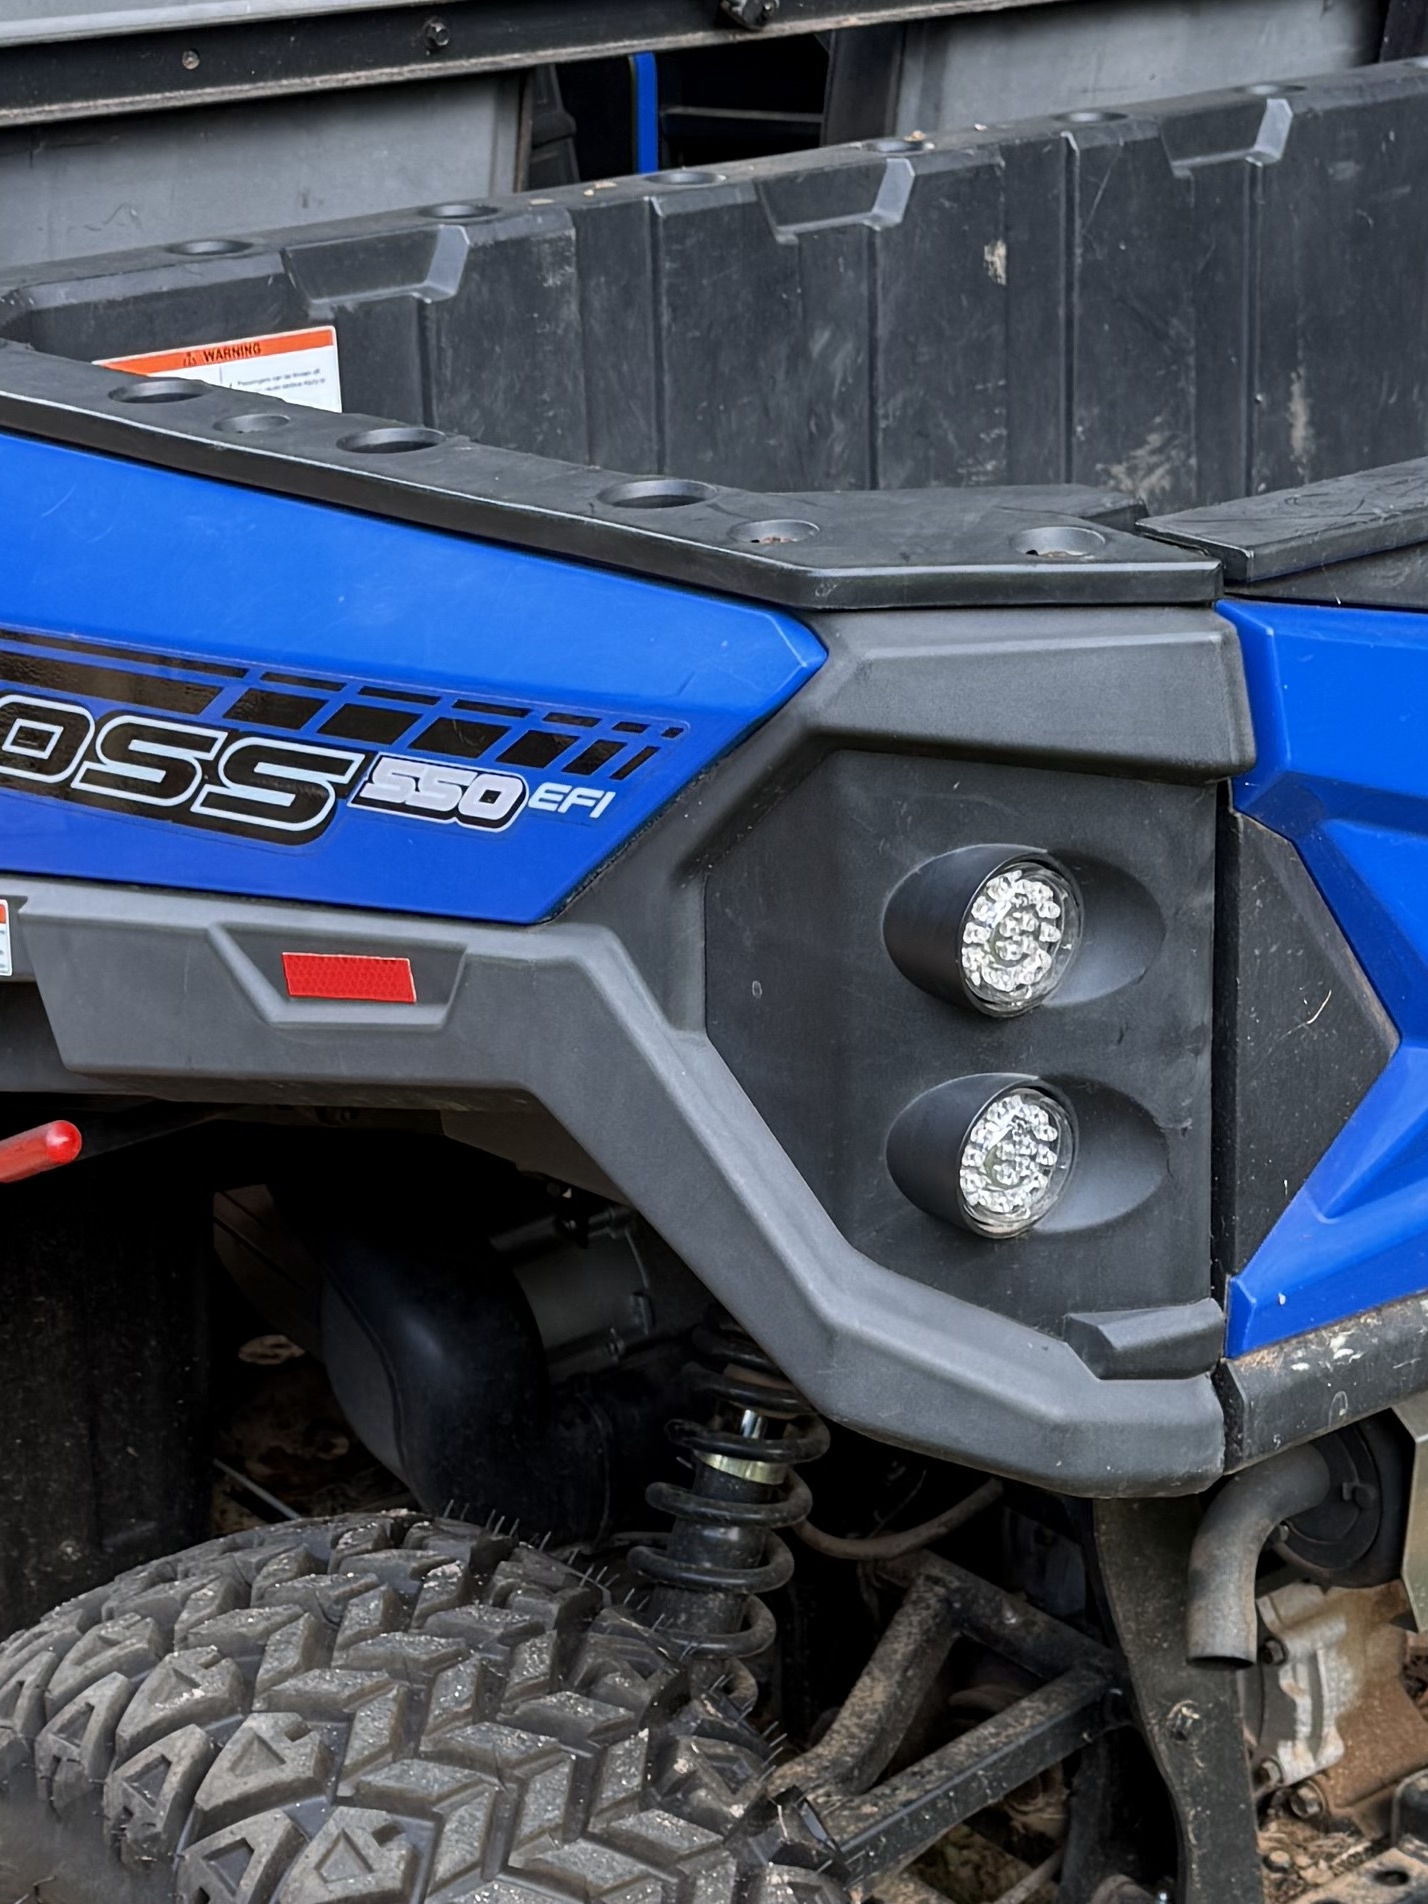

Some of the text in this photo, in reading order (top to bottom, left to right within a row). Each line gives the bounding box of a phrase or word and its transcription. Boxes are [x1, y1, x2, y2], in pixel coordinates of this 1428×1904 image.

[203, 342, 262, 363] WARNING
[356, 755, 526, 825] 550
[527, 781, 617, 819] EFI
